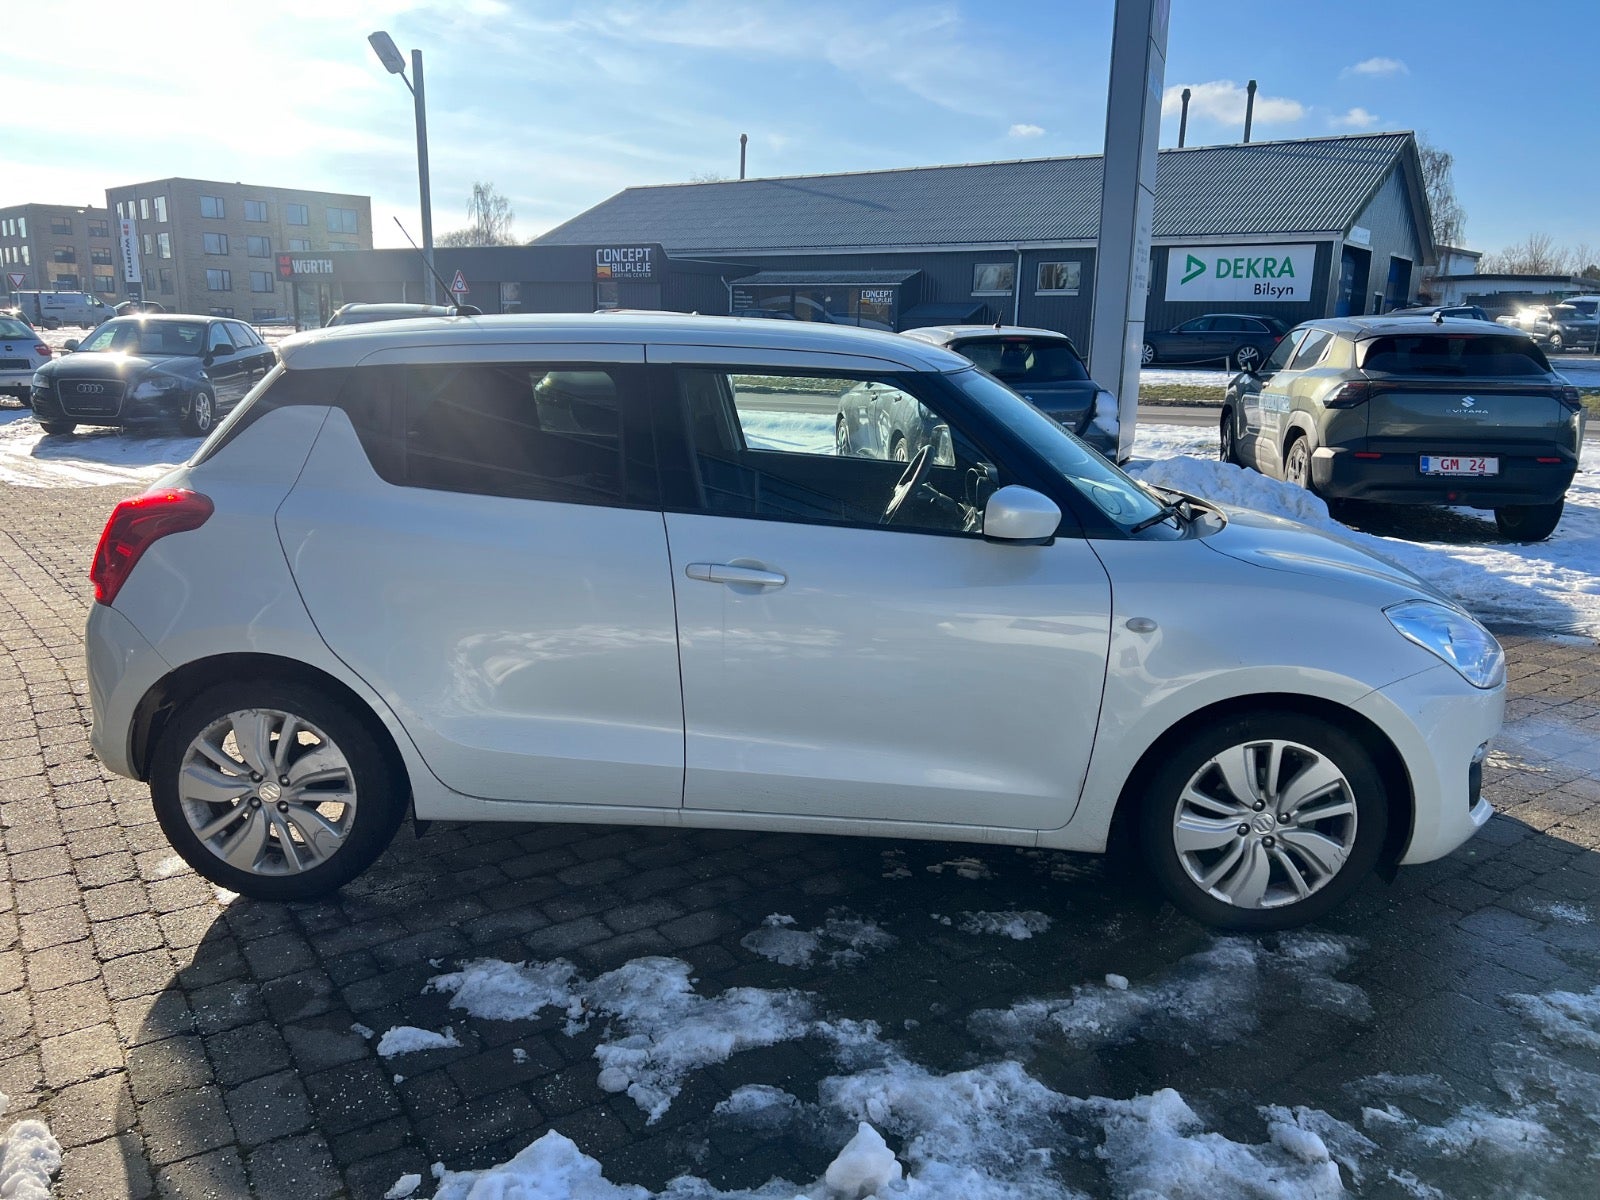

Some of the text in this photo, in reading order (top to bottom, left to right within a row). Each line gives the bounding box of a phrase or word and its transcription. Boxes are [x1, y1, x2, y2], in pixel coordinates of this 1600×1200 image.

[596, 248, 651, 266] CONCEPT
[292, 259, 333, 273] WÜRTH
[611, 263, 651, 272] BILPLEJE
[1215, 256, 1295, 279] DEKRA
[861, 290, 893, 299] CONCEPT
[1253, 282, 1294, 299] Bilsyn
[1441, 459, 1486, 471] GM 24
